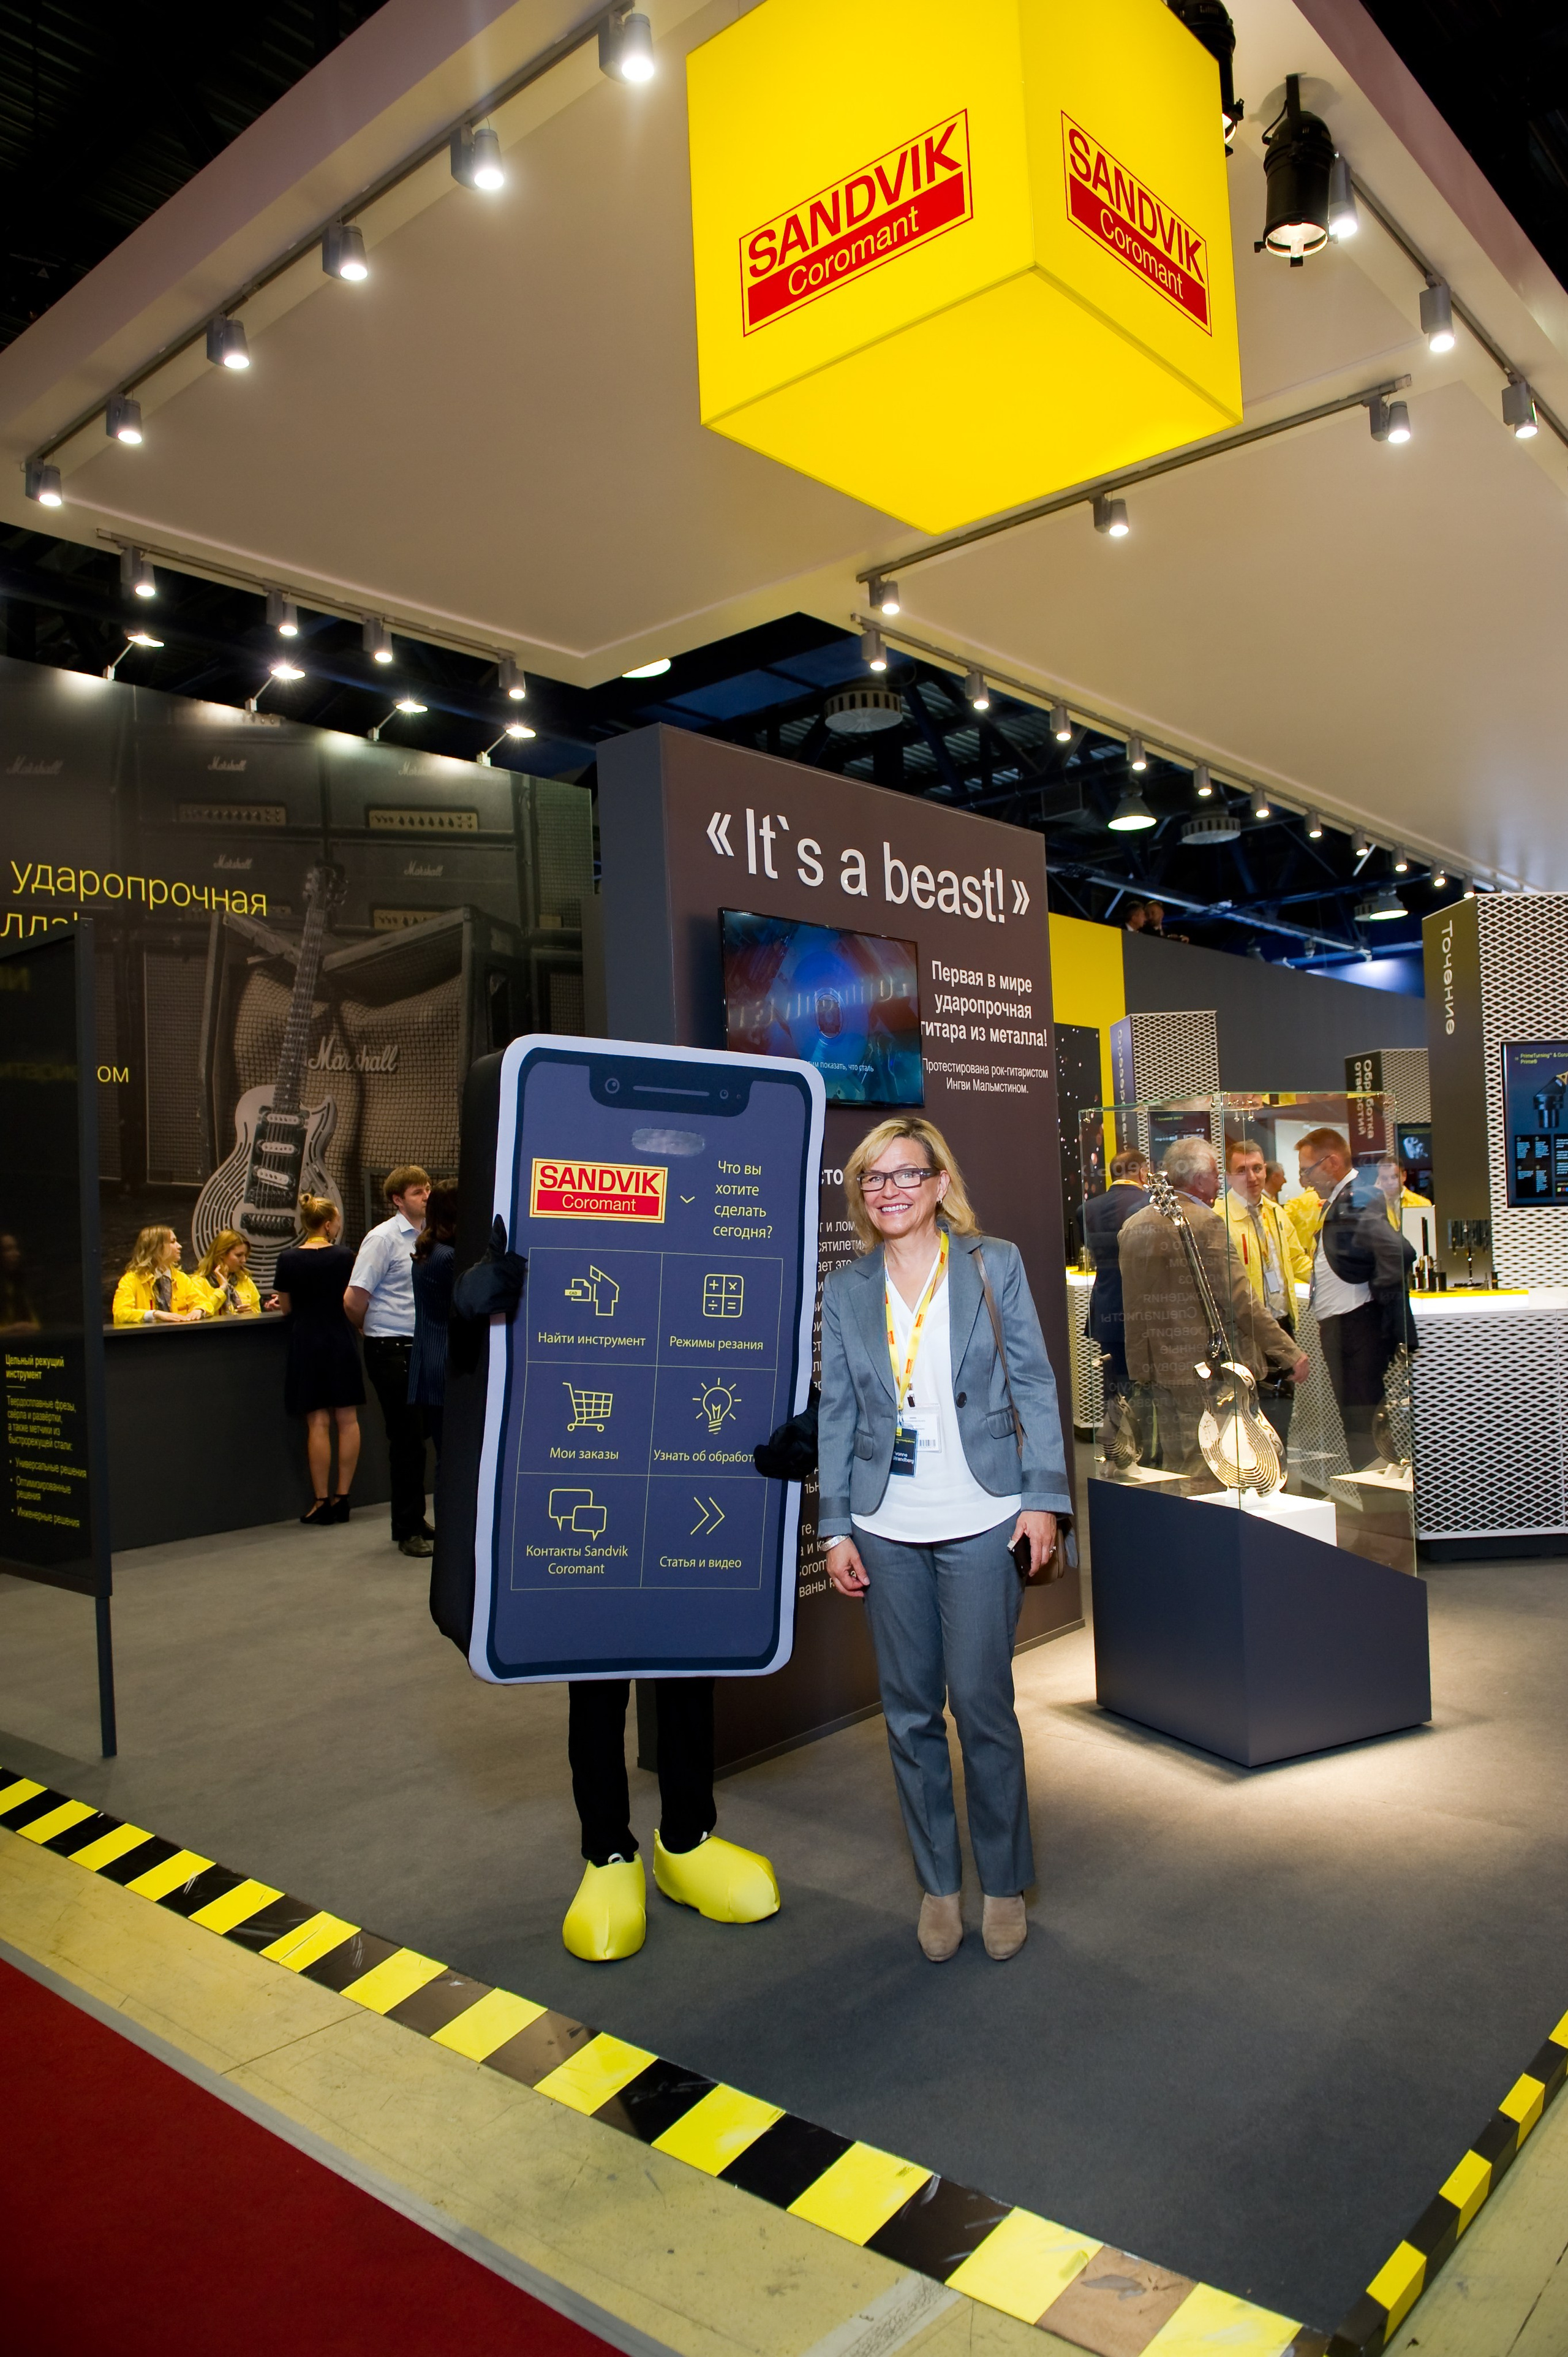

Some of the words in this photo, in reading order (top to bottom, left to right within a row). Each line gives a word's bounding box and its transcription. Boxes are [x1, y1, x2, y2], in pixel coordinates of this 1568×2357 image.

[748, 122, 962, 278] SANDVIK
[1068, 127, 1205, 284] SANDVIK
[788, 206, 919, 295] Coromant
[1099, 211, 1183, 300] Coromant
[840, 849, 868, 897] a
[11, 860, 267, 916] ударопрочная
[932, 960, 983, 987] Первая
[987, 974, 996, 988] в
[1000, 975, 1032, 996] мире
[1441, 920, 1455, 1035] Точение
[935, 994, 1032, 1019] ударопрочная
[921, 1021, 967, 1043] гитара
[970, 1026, 986, 1041] из
[990, 1028, 1047, 1047] металла!
[307, 1035, 398, 1072] Marshall
[97, 1065, 129, 1083] ом
[820, 1062, 847, 1071] показать,
[992, 1066, 1048, 1080] рок-гитаристом
[946, 1077, 971, 1091] Ингви
[973, 1079, 1029, 1093] Мальмстином.
[718, 1160, 741, 1175] Что
[745, 1165, 762, 1176] вы
[540, 1165, 660, 1195] SANDVIK
[821, 1169, 843, 1185] то
[715, 1184, 760, 1196] хотите
[562, 1194, 636, 1212] Coromant
[714, 1204, 767, 1218] сделать
[713, 1225, 772, 1239] сегодня?
[826, 1222, 832, 1232] и
[538, 1332, 575, 1344] Найти
[578, 1335, 646, 1349] инструмент
[669, 1336, 715, 1349] Режимы
[718, 1340, 763, 1352] резания
[6, 1354, 34, 1366] Цельный
[35, 1356, 64, 1369] режущий
[6, 1370, 42, 1381] инструмент
[6, 1395, 53, 1409] Твердосплавные
[55, 1399, 77, 1413] фрезы,
[13, 1423, 28, 1432] также
[29, 1424, 52, 1434] метчики
[53, 1427, 61, 1436] из
[8, 1434, 53, 1449] быстрорежущей
[550, 1448, 576, 1459] Мои
[579, 1450, 619, 1459] заказы
[654, 1450, 690, 1462] Узнать
[693, 1450, 706, 1462] об
[709, 1451, 755, 1464] обработ
[15, 1457, 59, 1472] Универсальные
[60, 1465, 87, 1478] решения
[16, 1475, 72, 1494] Оптимизированные
[17, 1490, 41, 1500] решения
[17, 1507, 53, 1523] Инженерные
[54, 1515, 80, 1528] решения
[526, 1545, 581, 1557] Контакты
[584, 1545, 628, 1557] Sandvik
[548, 1563, 605, 1574] Coromant
[660, 1556, 696, 1568] Статья
[699, 1558, 705, 1568] и
[708, 1559, 742, 1570] видео
